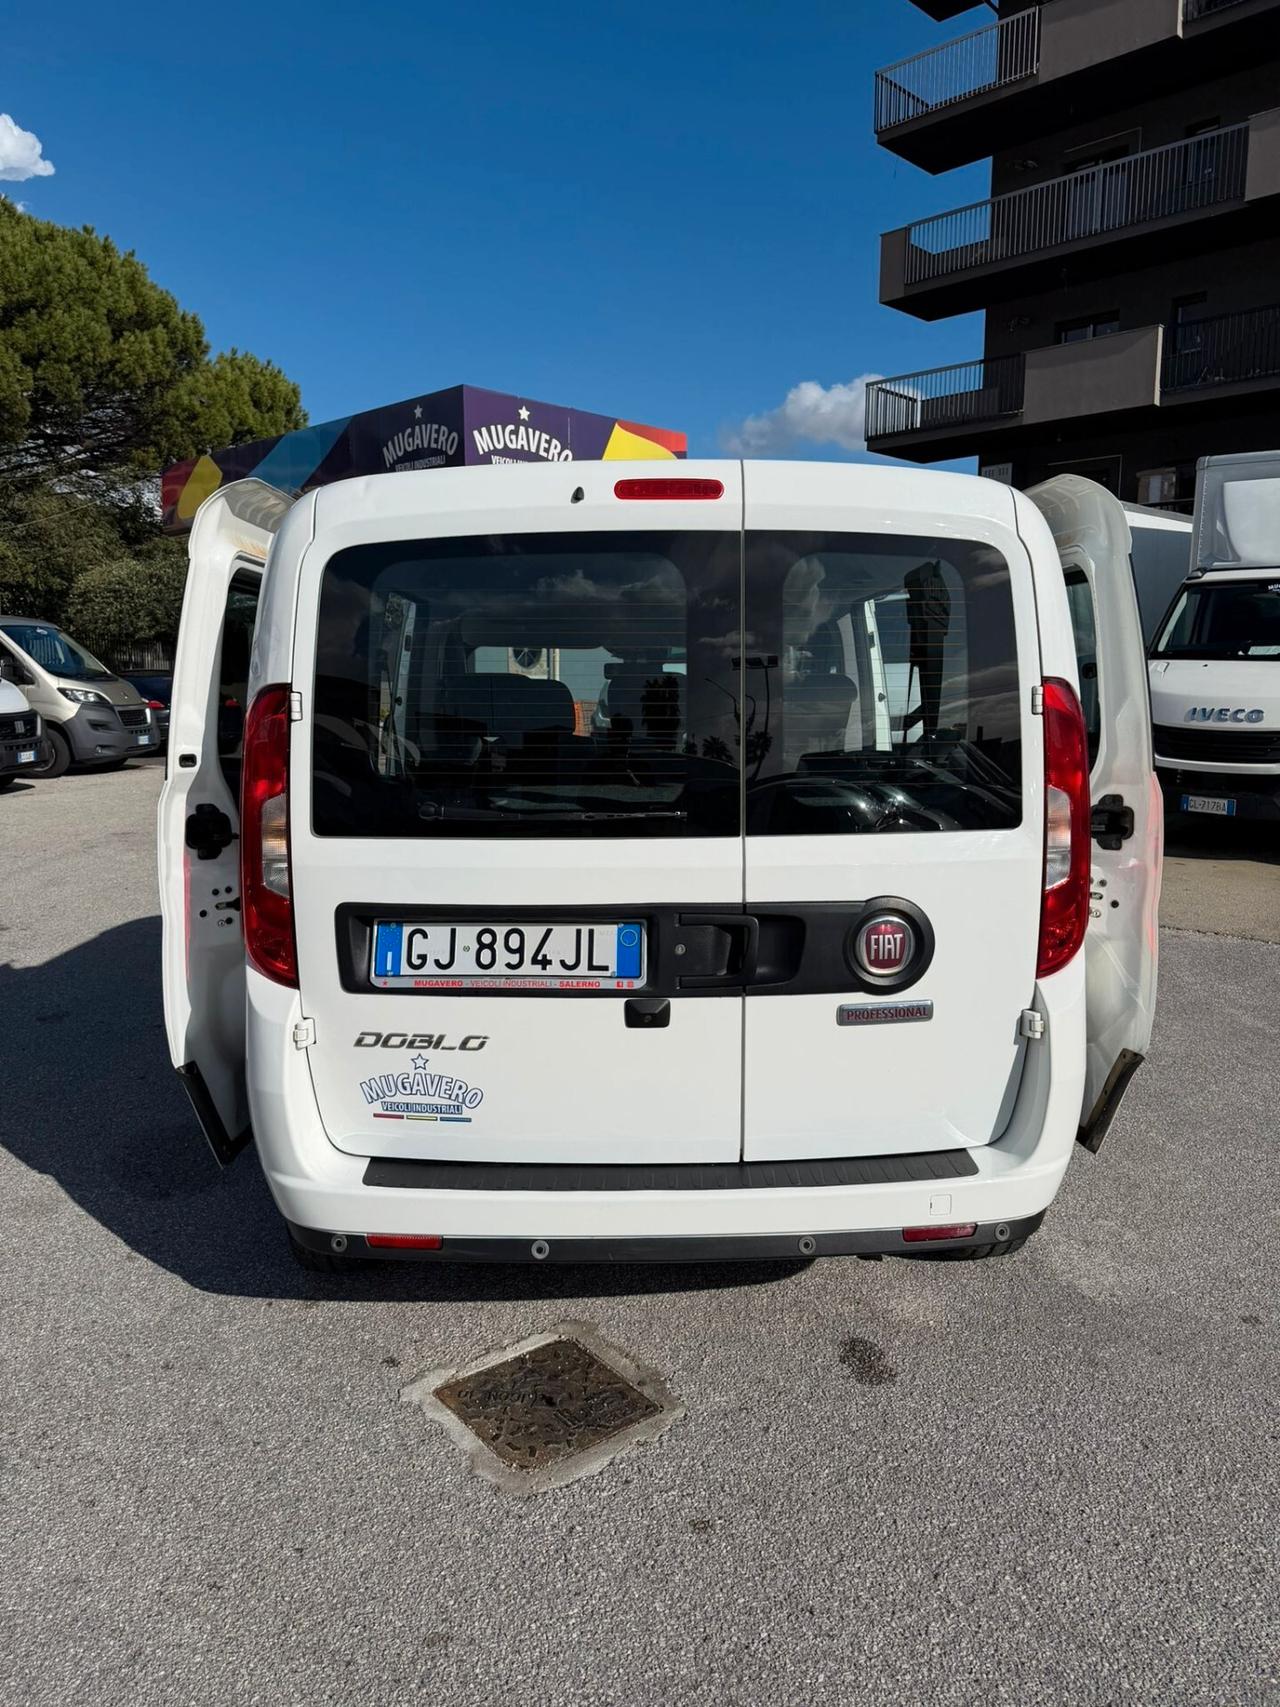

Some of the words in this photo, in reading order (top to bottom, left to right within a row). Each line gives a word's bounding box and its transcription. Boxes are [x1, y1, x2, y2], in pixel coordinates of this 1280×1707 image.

[382, 424, 459, 468] MUGAVERO
[1184, 707, 1264, 723] IVECO
[870, 934, 903, 960] FIAT
[470, 980, 502, 988] VEICOLI
[503, 980, 553, 988] INDUSTRIALI
[559, 980, 601, 988] SALERNO
[847, 1006, 928, 1020] PROFESSIONAL
[360, 1072, 484, 1109] MUGAVERO
[382, 1102, 411, 1113] VEICOLI
[413, 1103, 462, 1114] INDUSTRIALI
